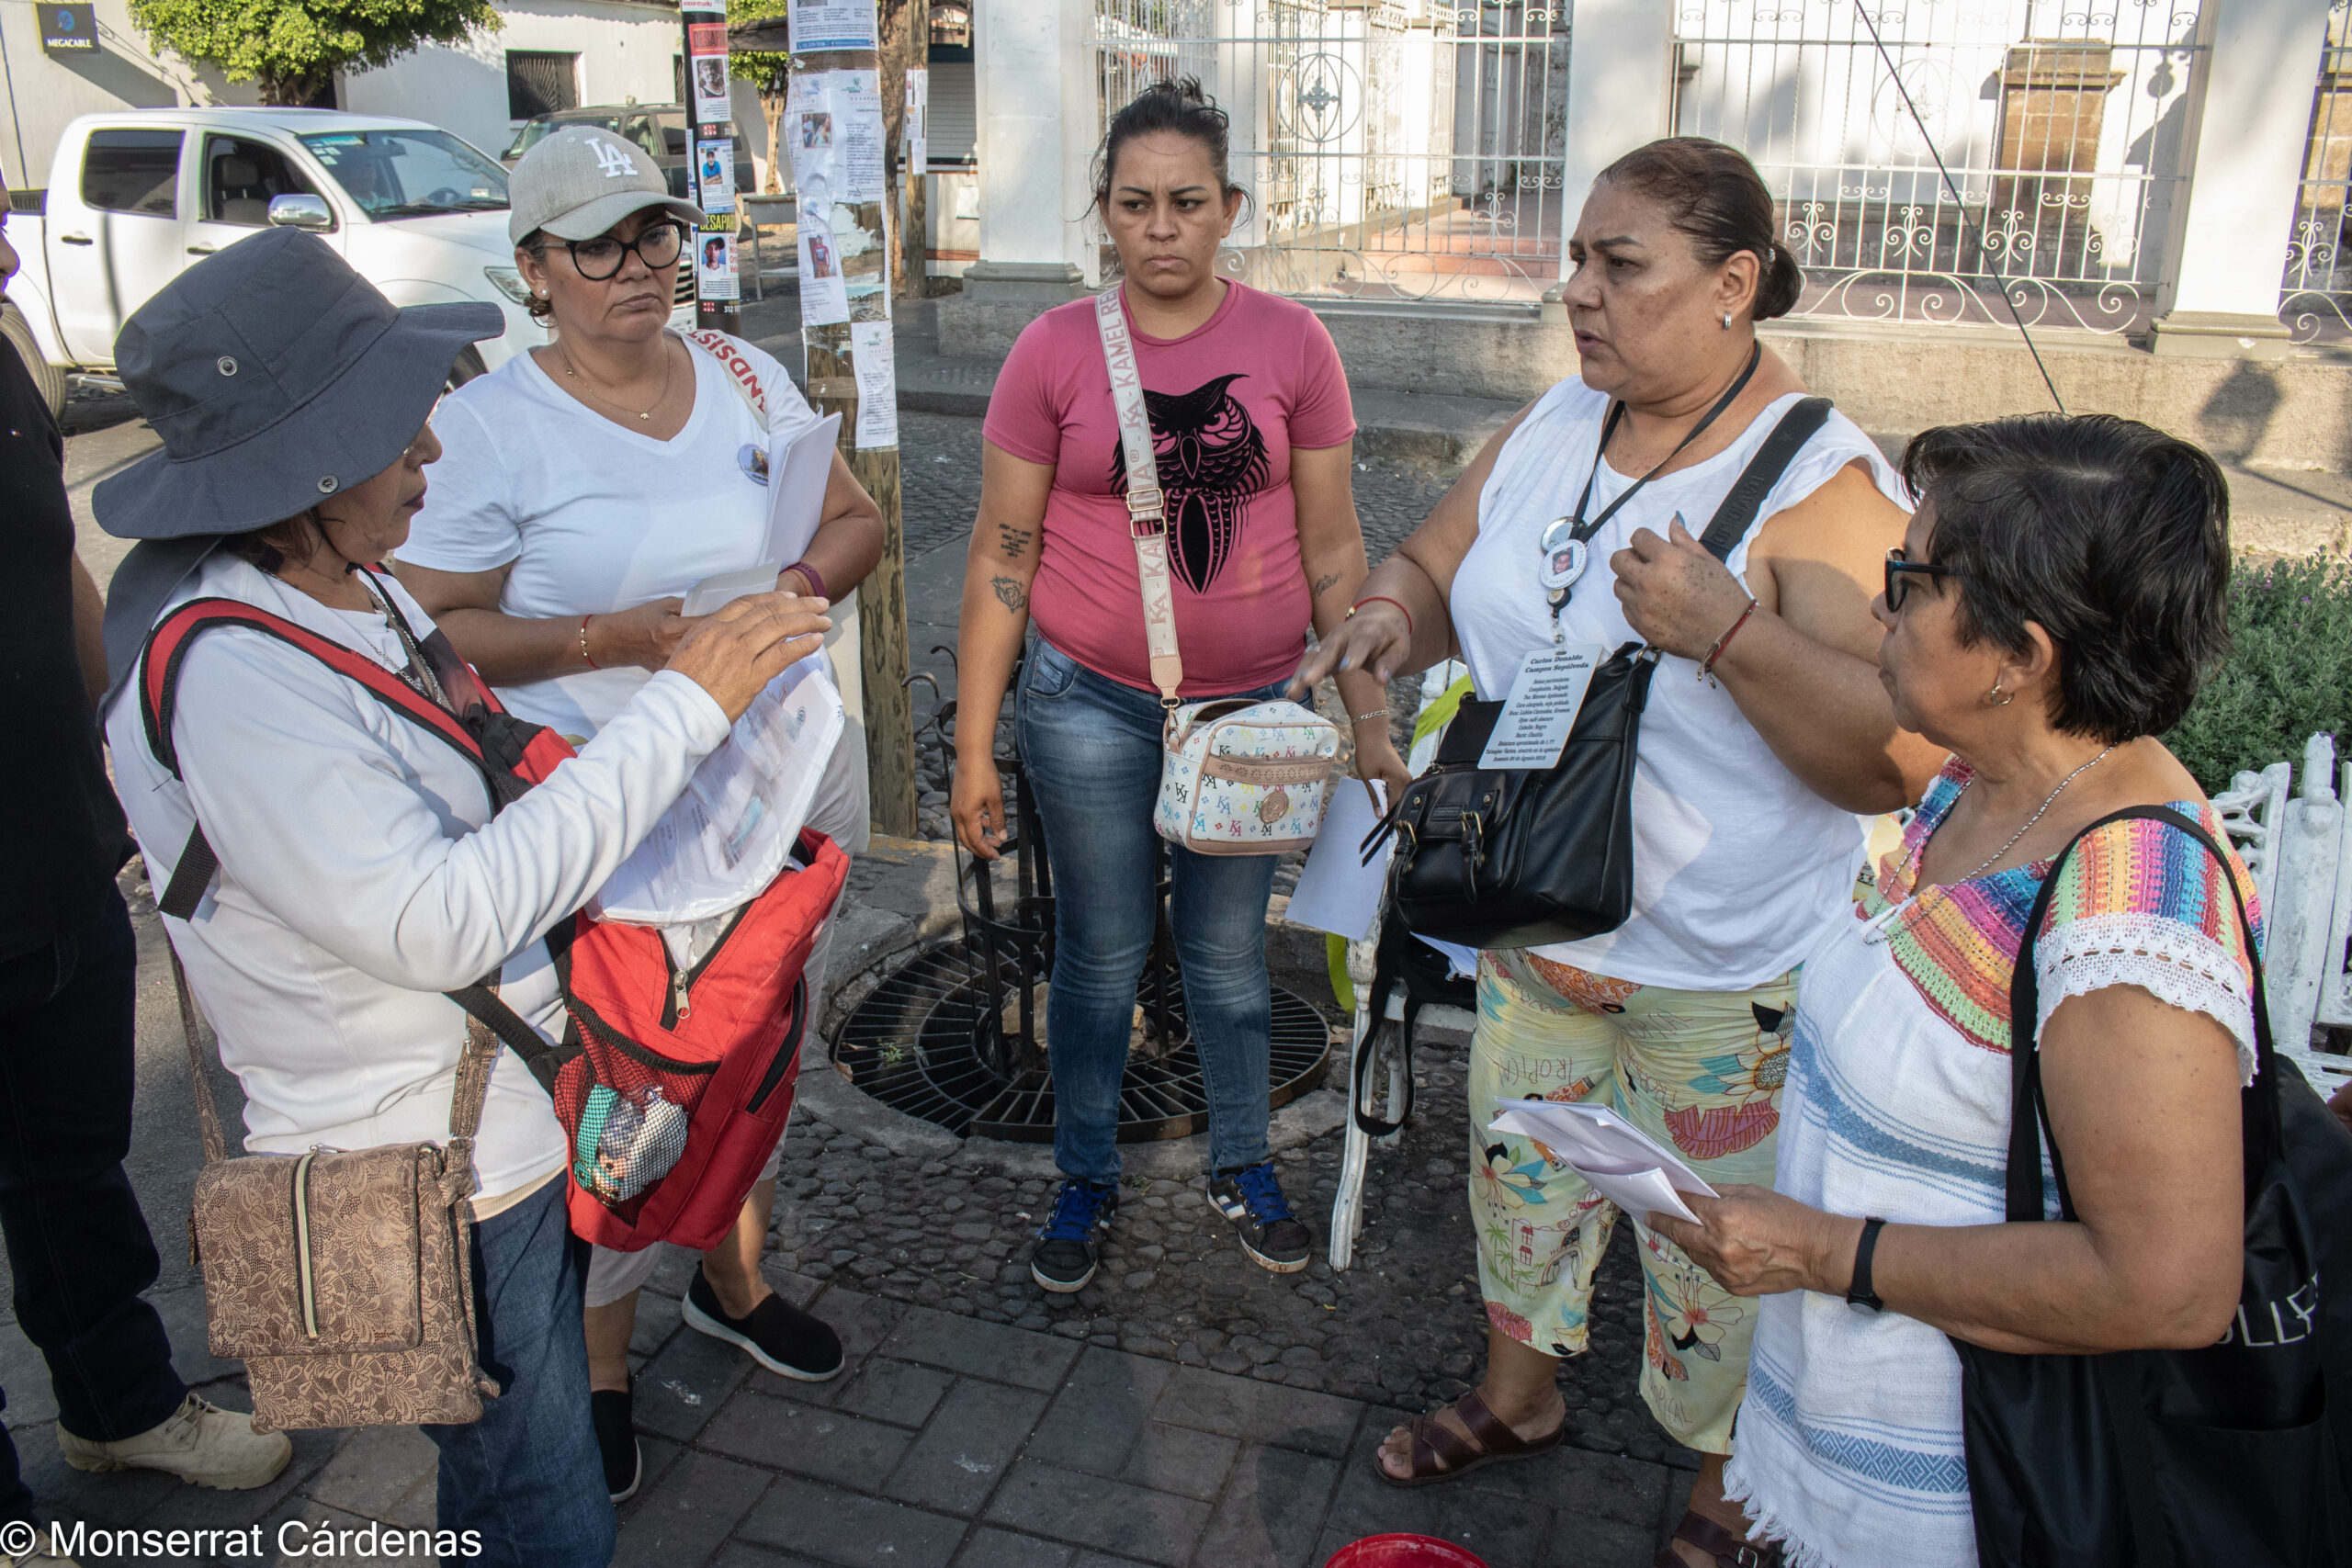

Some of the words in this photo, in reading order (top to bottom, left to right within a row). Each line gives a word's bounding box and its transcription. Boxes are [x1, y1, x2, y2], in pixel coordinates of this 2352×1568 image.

[47, 39, 93, 48] MEGACABLE
[584, 138, 639, 178] LA
[1103, 318, 1136, 388] KAMEL
